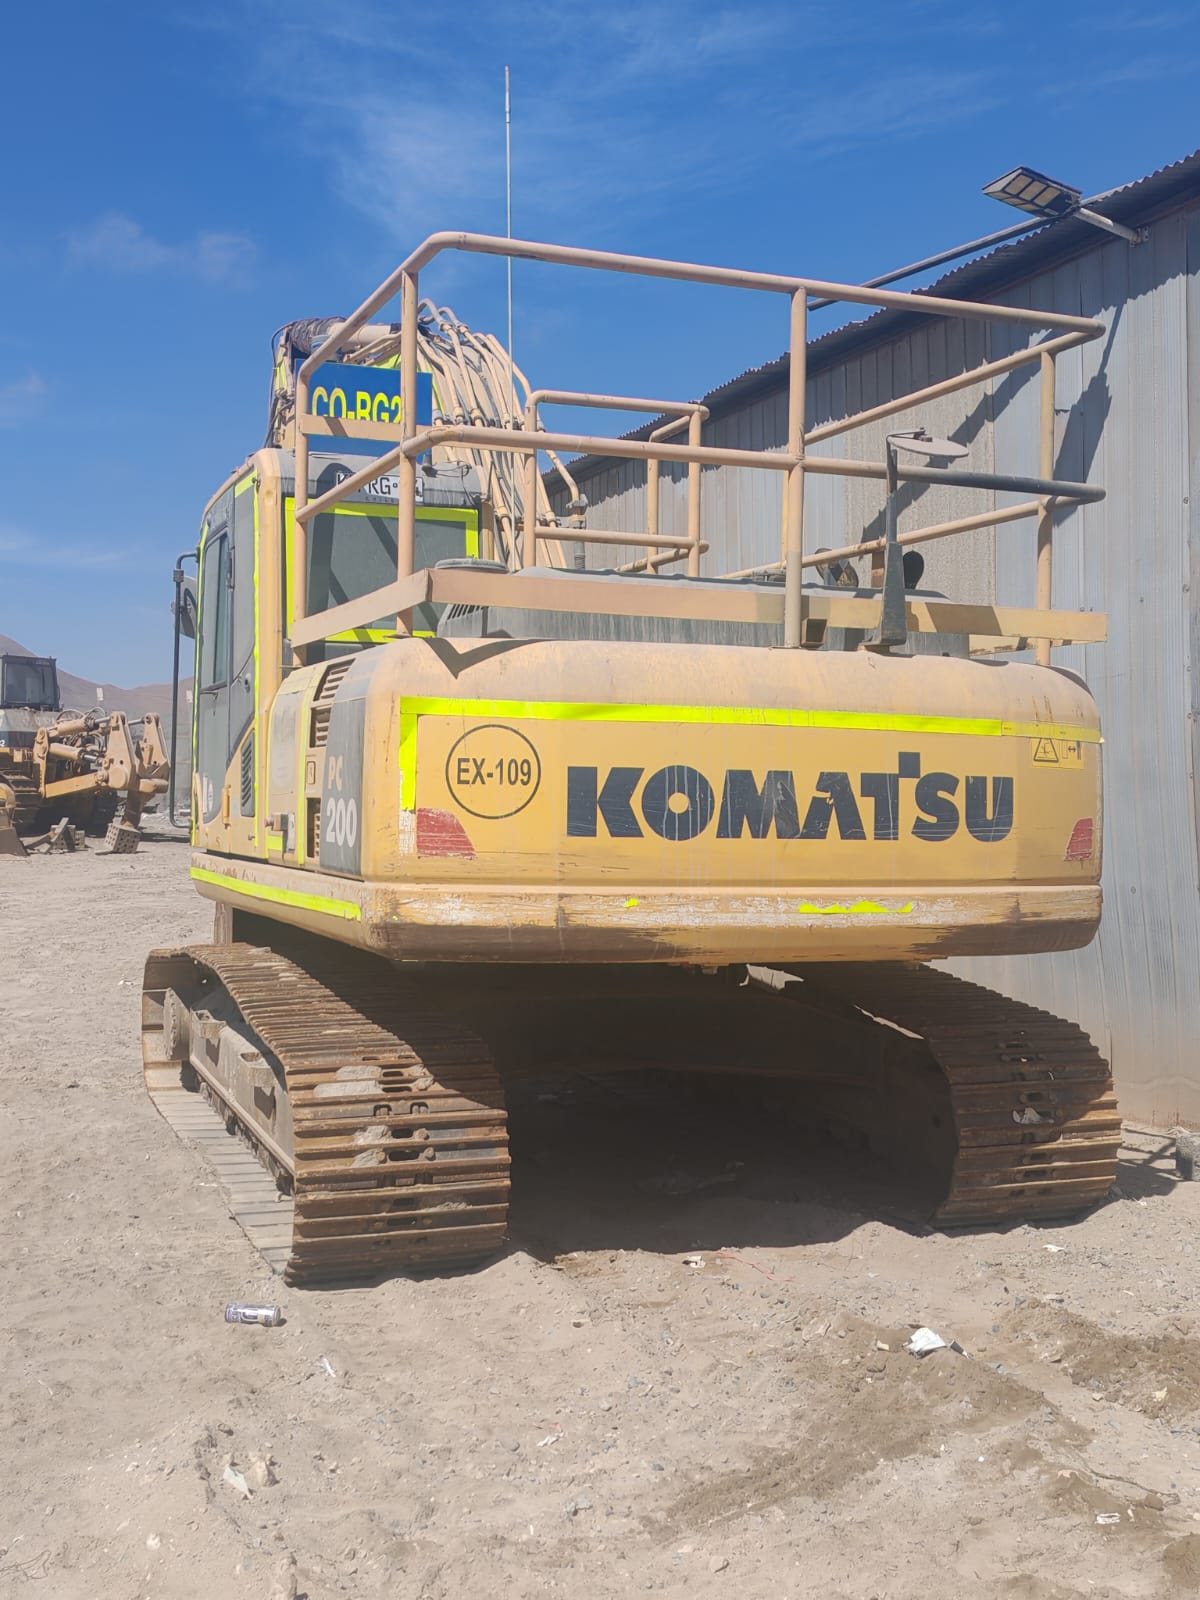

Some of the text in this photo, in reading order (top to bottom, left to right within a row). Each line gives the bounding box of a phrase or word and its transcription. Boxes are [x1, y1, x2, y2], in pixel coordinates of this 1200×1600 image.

[312, 386, 402, 424] CO-RG2
[327, 755, 344, 791] PC
[457, 757, 532, 786] EX-109
[567, 752, 1014, 842] KOMATSU
[326, 797, 358, 848] 200
